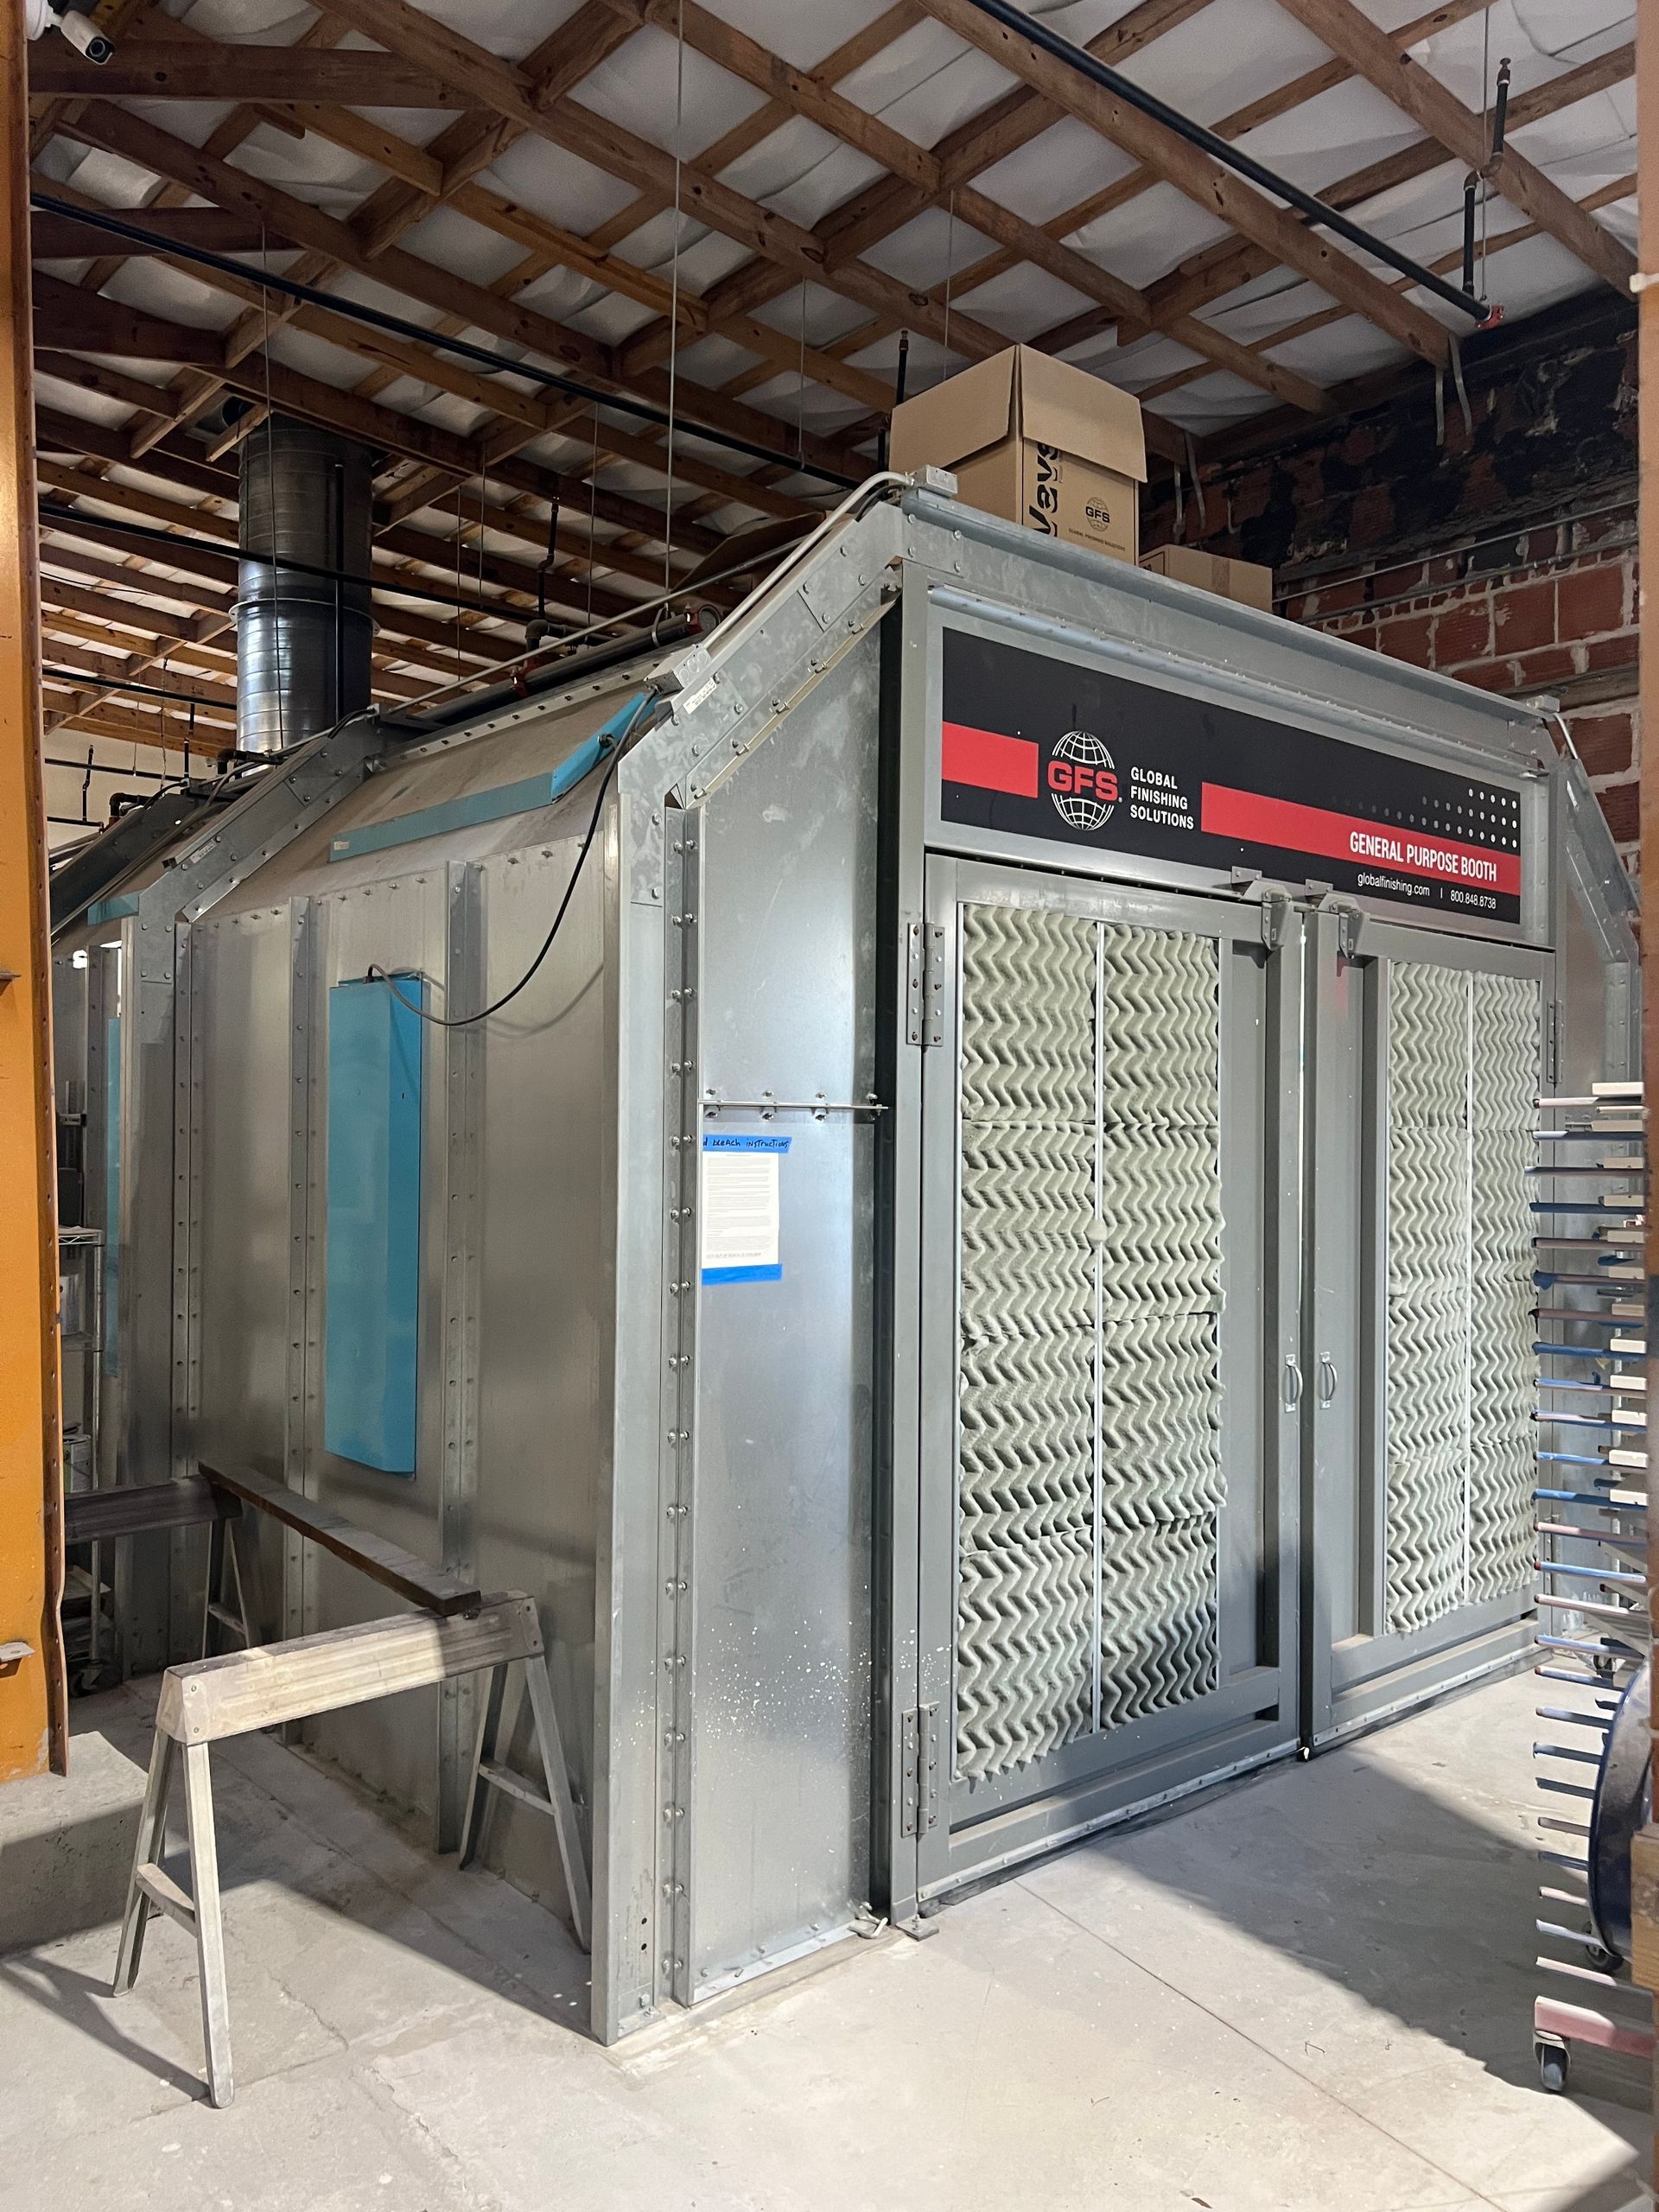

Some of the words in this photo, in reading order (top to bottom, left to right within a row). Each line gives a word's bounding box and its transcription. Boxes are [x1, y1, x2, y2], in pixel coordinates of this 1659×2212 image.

[1085, 506, 1110, 524] GFS
[1047, 760, 1118, 801] GFS
[1130, 766, 1178, 789] GLOBAL
[1130, 785, 1188, 810] FINISHING
[1130, 804, 1194, 830] SOLUTIONS
[1350, 831, 1404, 862] GENERAL
[1407, 844, 1459, 874] PURPOSE
[1461, 856, 1497, 882] BOOTH
[1357, 872, 1430, 896] globalfinishing.com
[1451, 889, 1497, 909] 800.848.8738
